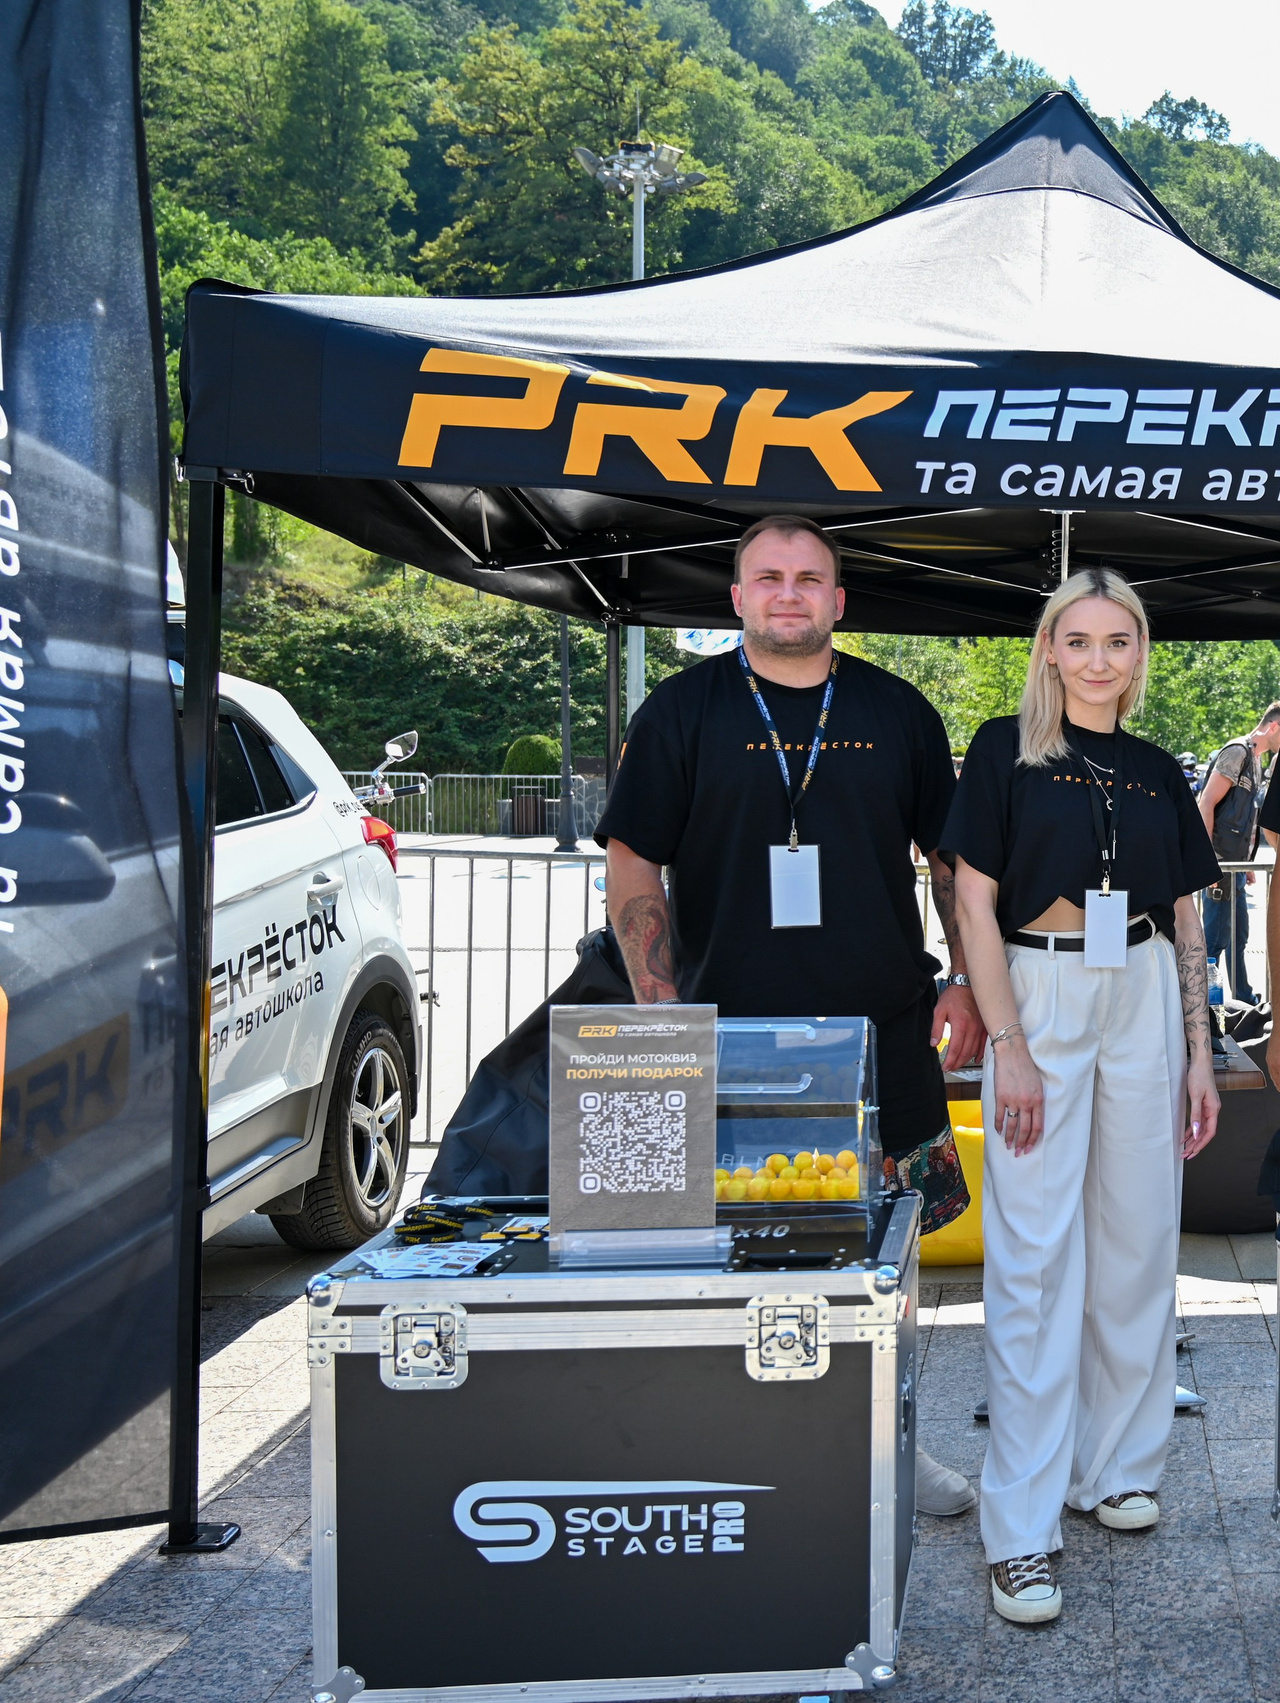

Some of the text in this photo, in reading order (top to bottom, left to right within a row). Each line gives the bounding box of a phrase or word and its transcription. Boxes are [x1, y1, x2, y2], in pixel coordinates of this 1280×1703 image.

[398, 348, 913, 492] PRK
[914, 461, 977, 495] та
[999, 462, 1183, 500] самая
[747, 741, 874, 751] ПЕЕКЁСТОК
[1053, 775, 1156, 797] ПЕРЕКРСТК
[235, 971, 324, 1041] автошкола
[580, 1026, 615, 1036] PRK
[618, 1023, 688, 1032] ПЕРЕКРЁСТОК
[350, 1030, 373, 1078] KUMHO
[570, 1052, 697, 1065] ПРОЙДИ МОТОКВИЗ
[566, 1066, 703, 1080] ПОЛУЧИ ПОДАРОК
[565, 1503, 708, 1533] SOUTH
[712, 1501, 746, 1552] PRO
[568, 1534, 704, 1556] STAGE
